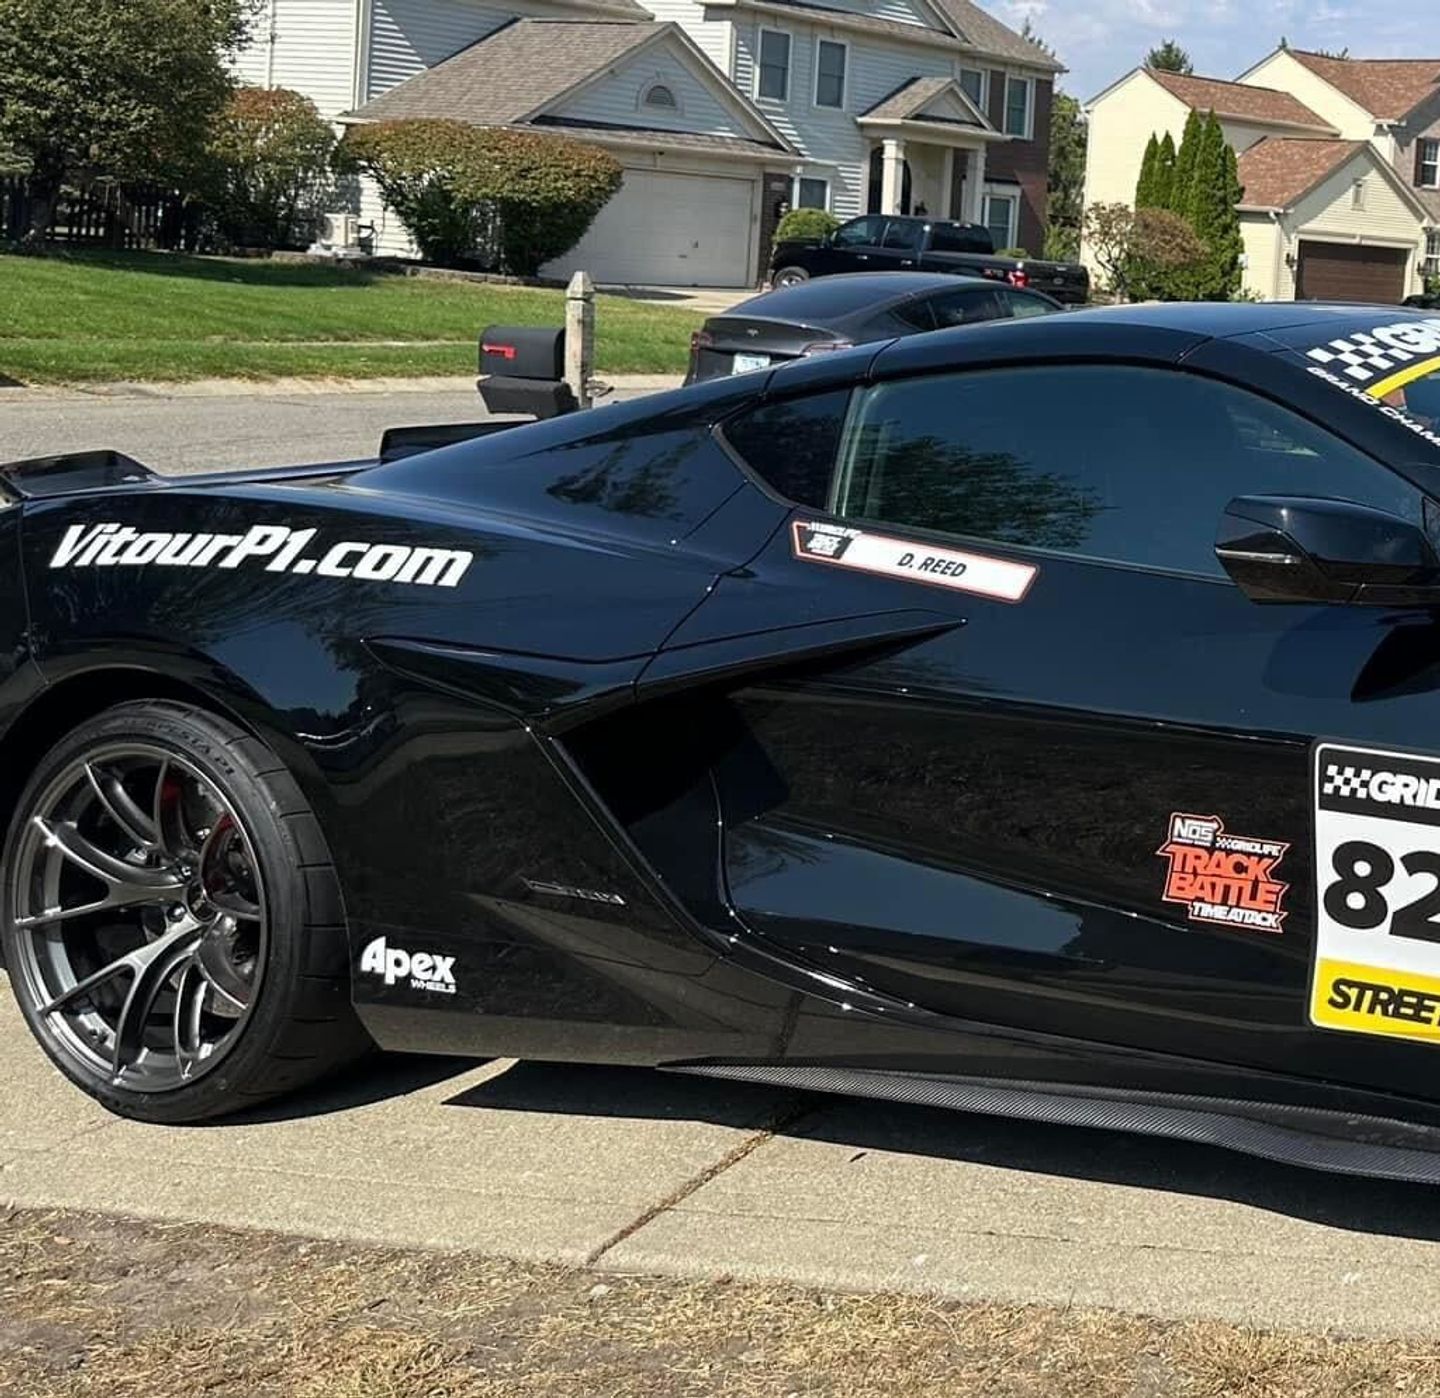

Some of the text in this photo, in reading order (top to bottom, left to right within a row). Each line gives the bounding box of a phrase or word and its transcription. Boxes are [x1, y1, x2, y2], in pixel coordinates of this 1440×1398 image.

[1306, 367, 1380, 406] GRAND
[49, 523, 474, 588] VitourP1.com
[897, 552, 967, 577] D. REED
[1173, 817, 1219, 843] NOS
[1164, 843, 1274, 881] TRACK
[1167, 872, 1282, 912] BATTLE
[361, 936, 457, 985] Apex
